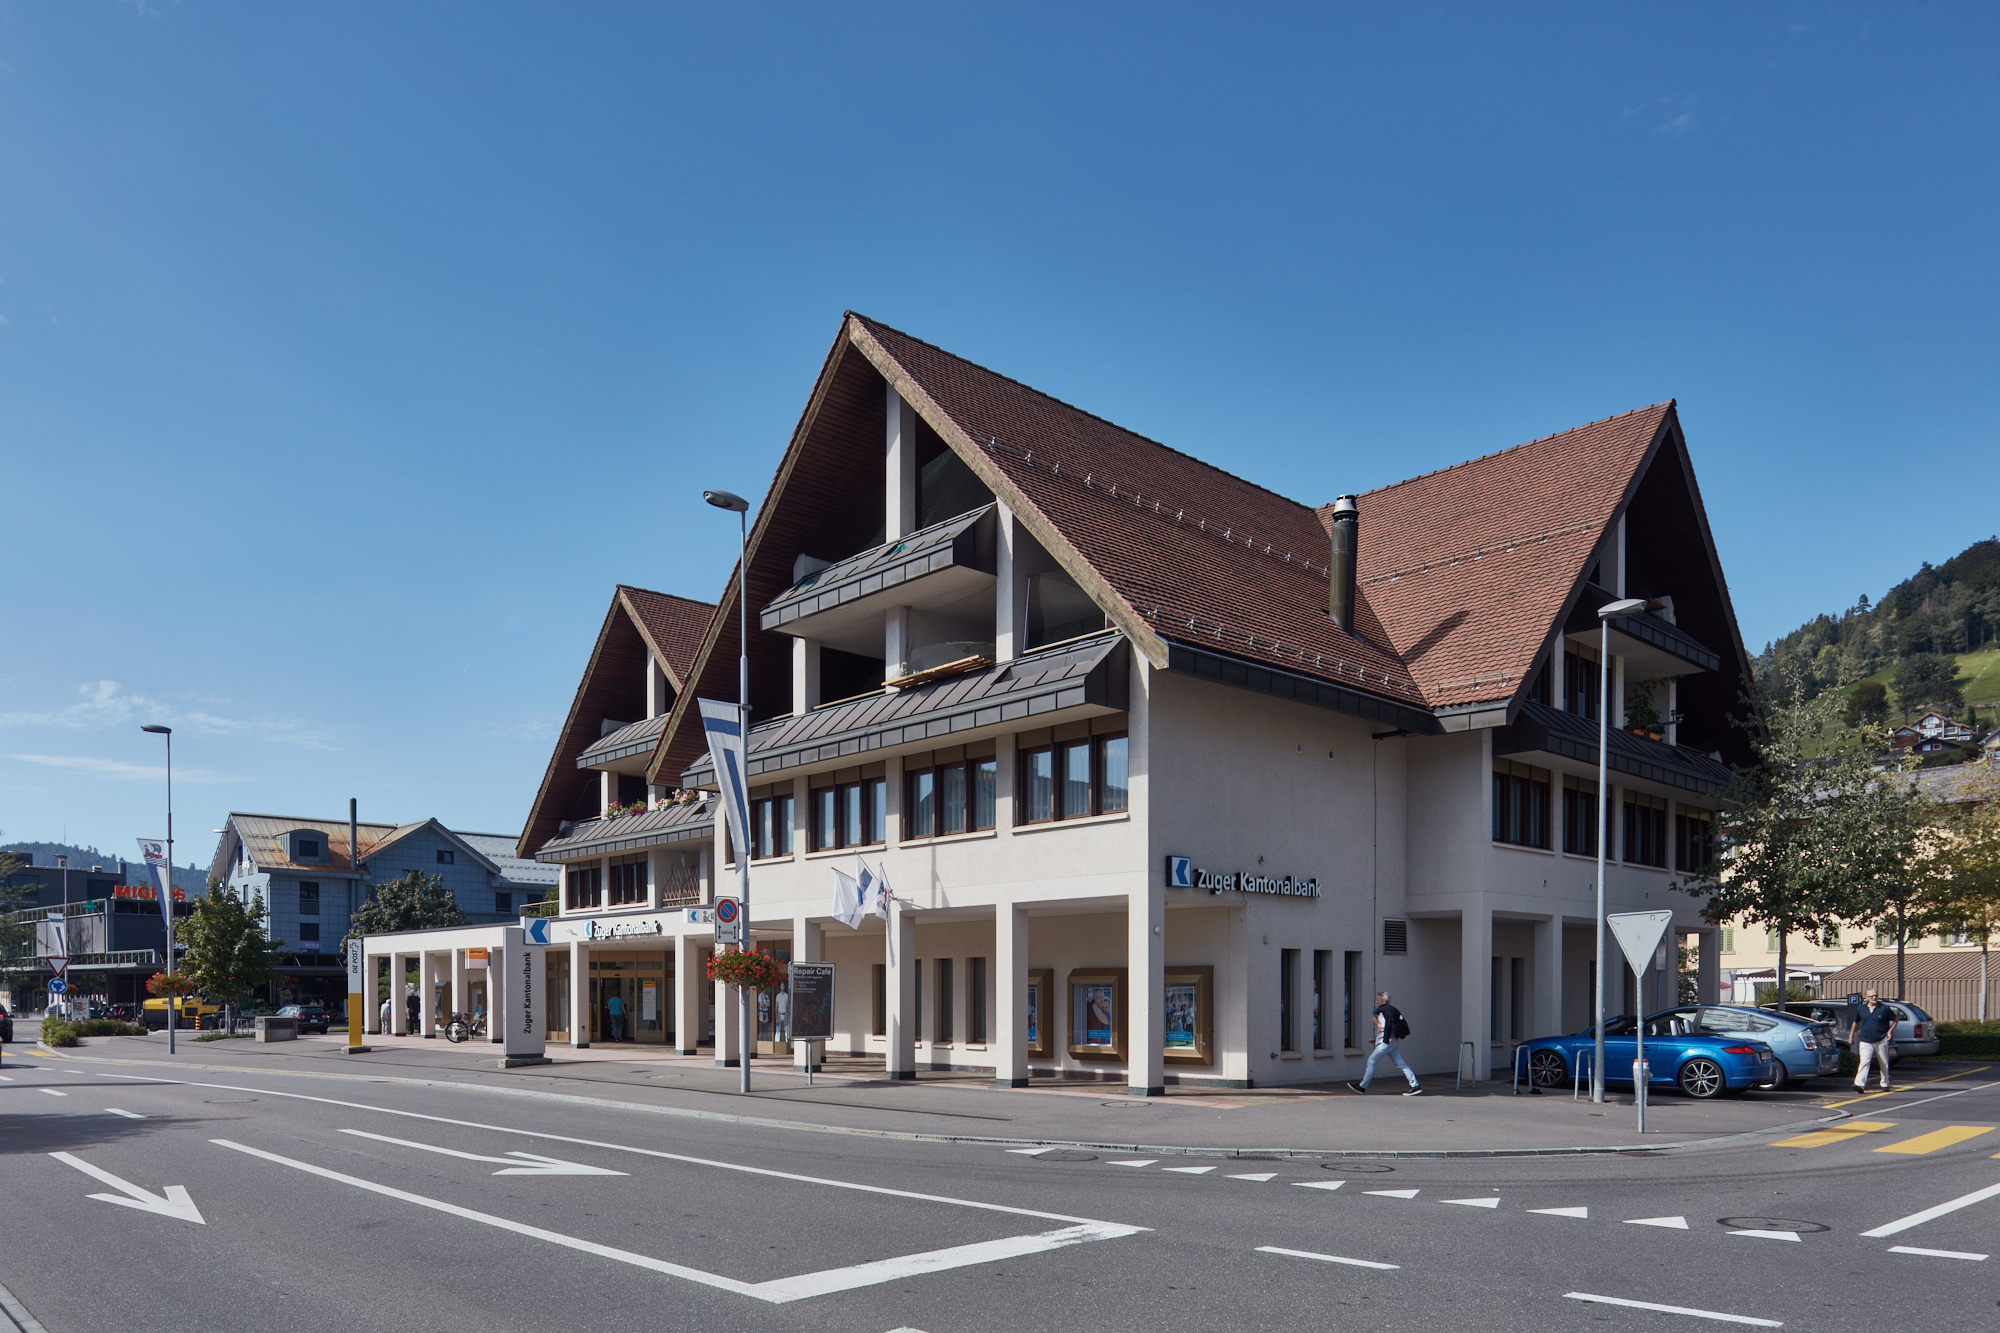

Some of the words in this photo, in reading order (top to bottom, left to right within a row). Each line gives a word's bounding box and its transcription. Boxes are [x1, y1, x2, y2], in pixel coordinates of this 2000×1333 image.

[1197, 869, 1237, 895] Zuger
[1240, 871, 1323, 898] Kantonalbank
[593, 925, 612, 940] Zuger
[613, 921, 658, 936] Kantonalbank
[523, 951, 532, 1009] Kantonalbank
[794, 967, 815, 976] Repair
[816, 967, 831, 976] Café
[524, 1010, 533, 1034] Zuger
